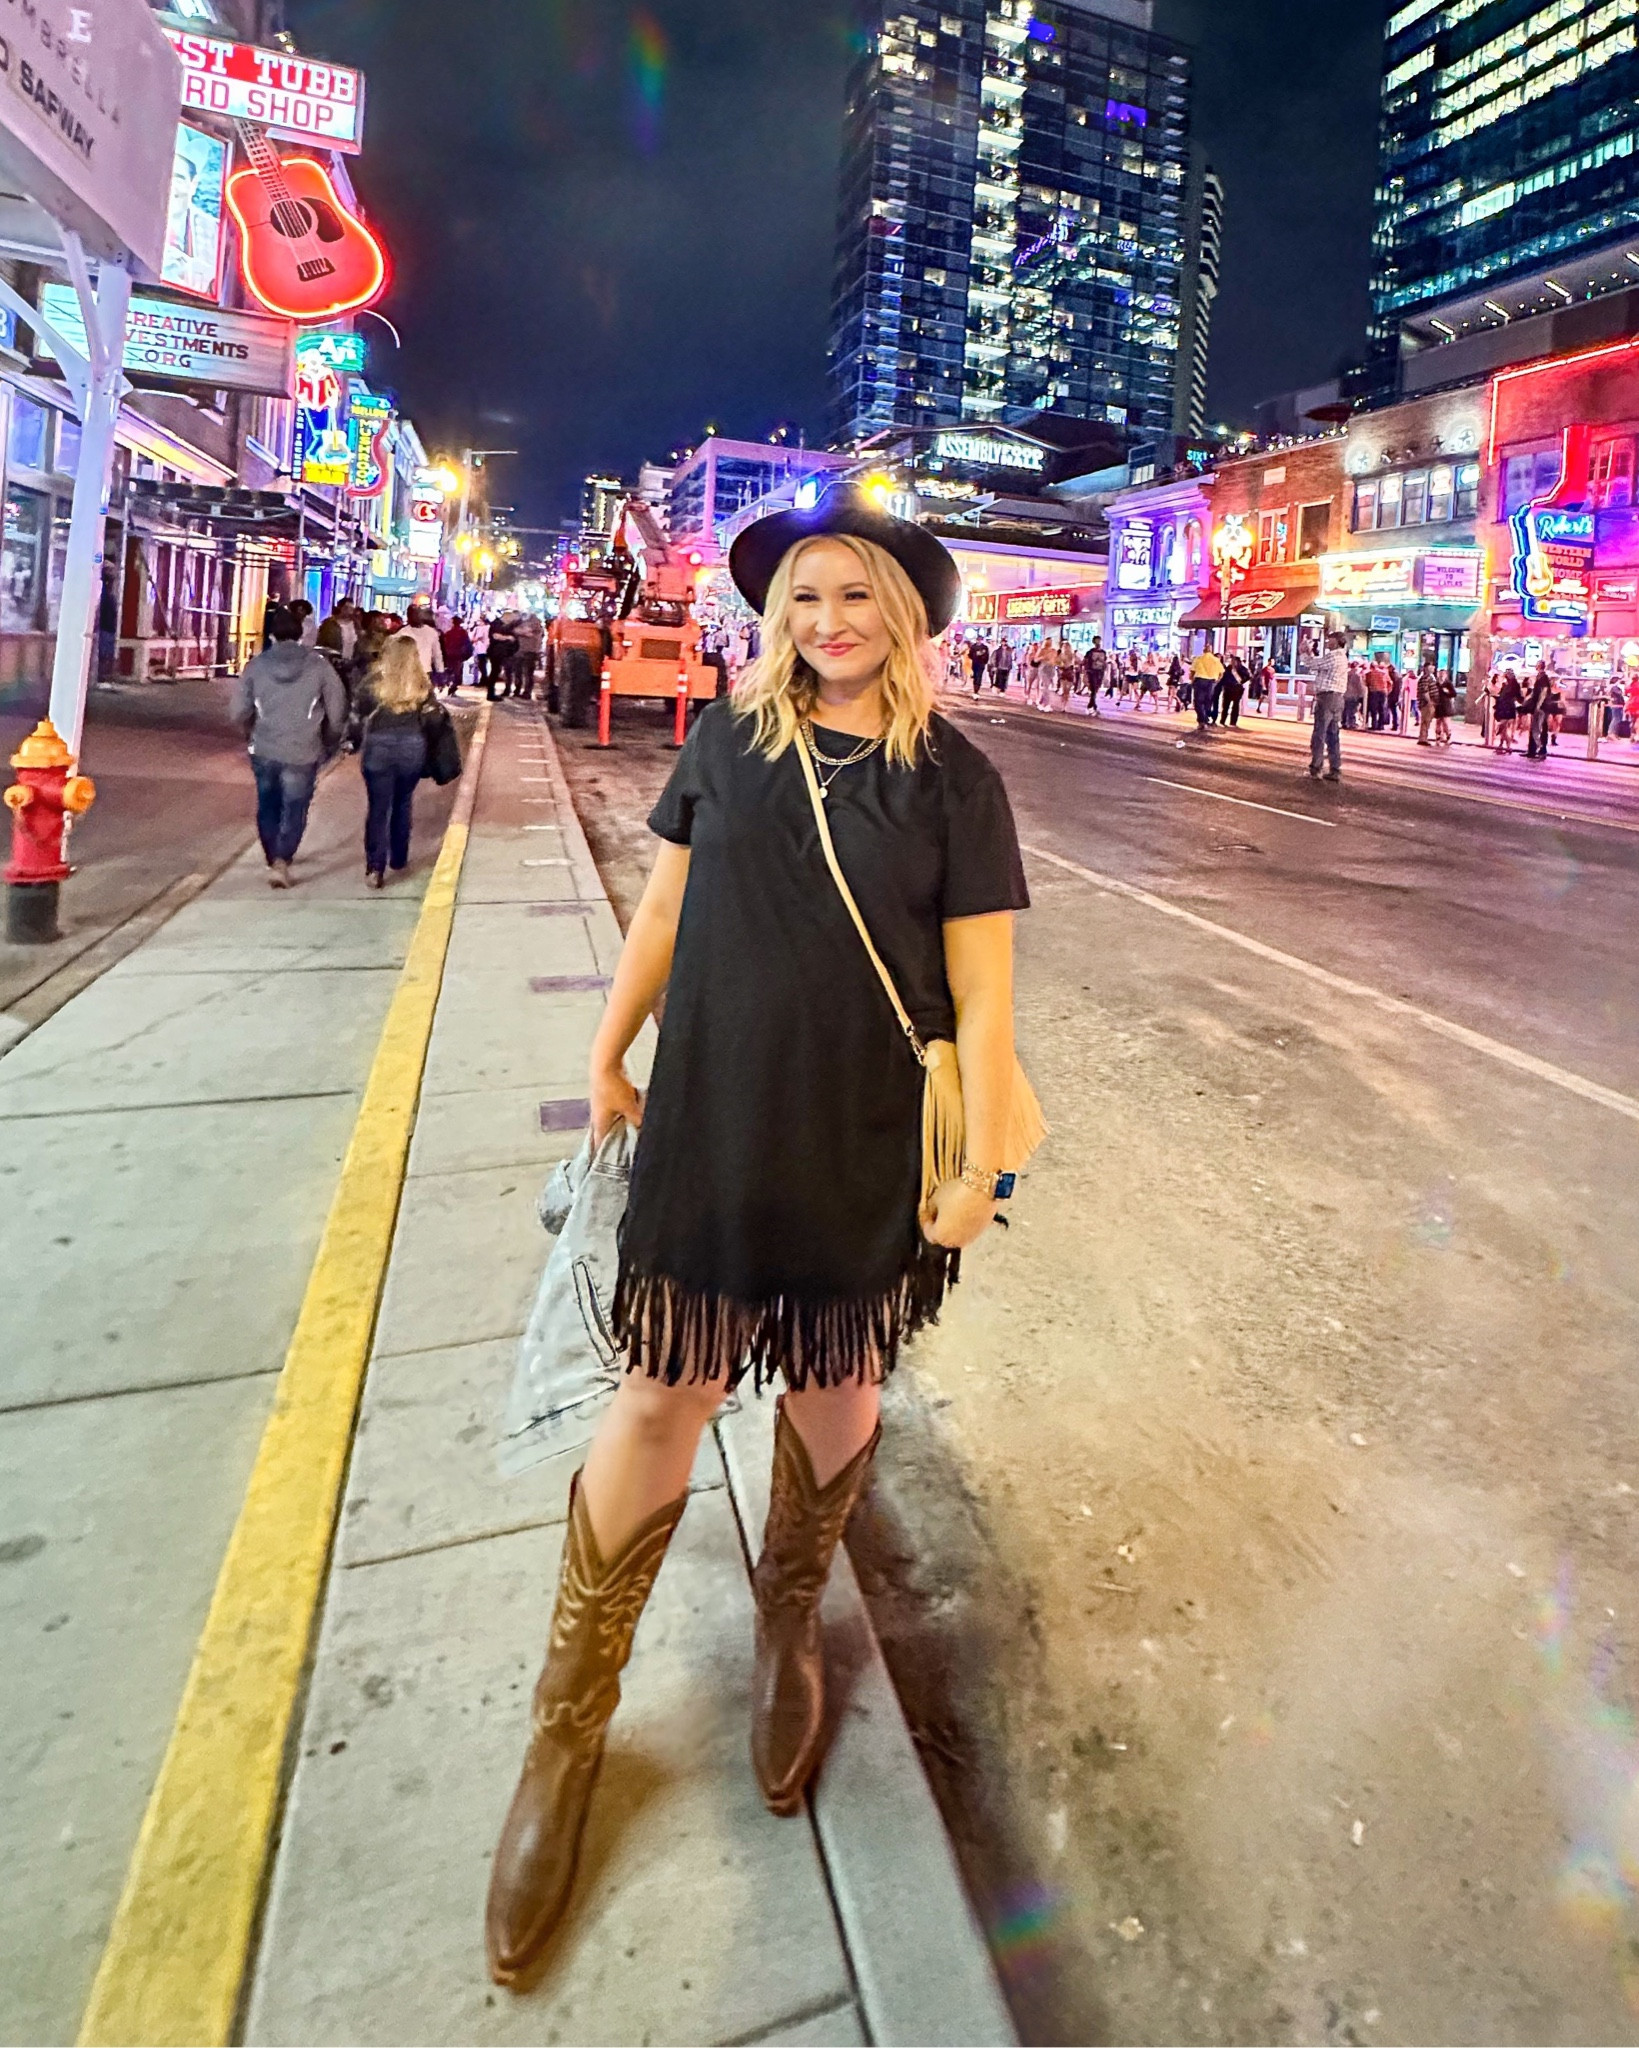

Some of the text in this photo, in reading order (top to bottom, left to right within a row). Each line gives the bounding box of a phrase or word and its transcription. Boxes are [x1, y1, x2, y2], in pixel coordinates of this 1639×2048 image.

[185, 74, 334, 130] RD SHOP
[253, 49, 355, 102] TUBB
[937, 434, 1001, 464] ASSEMBLY
